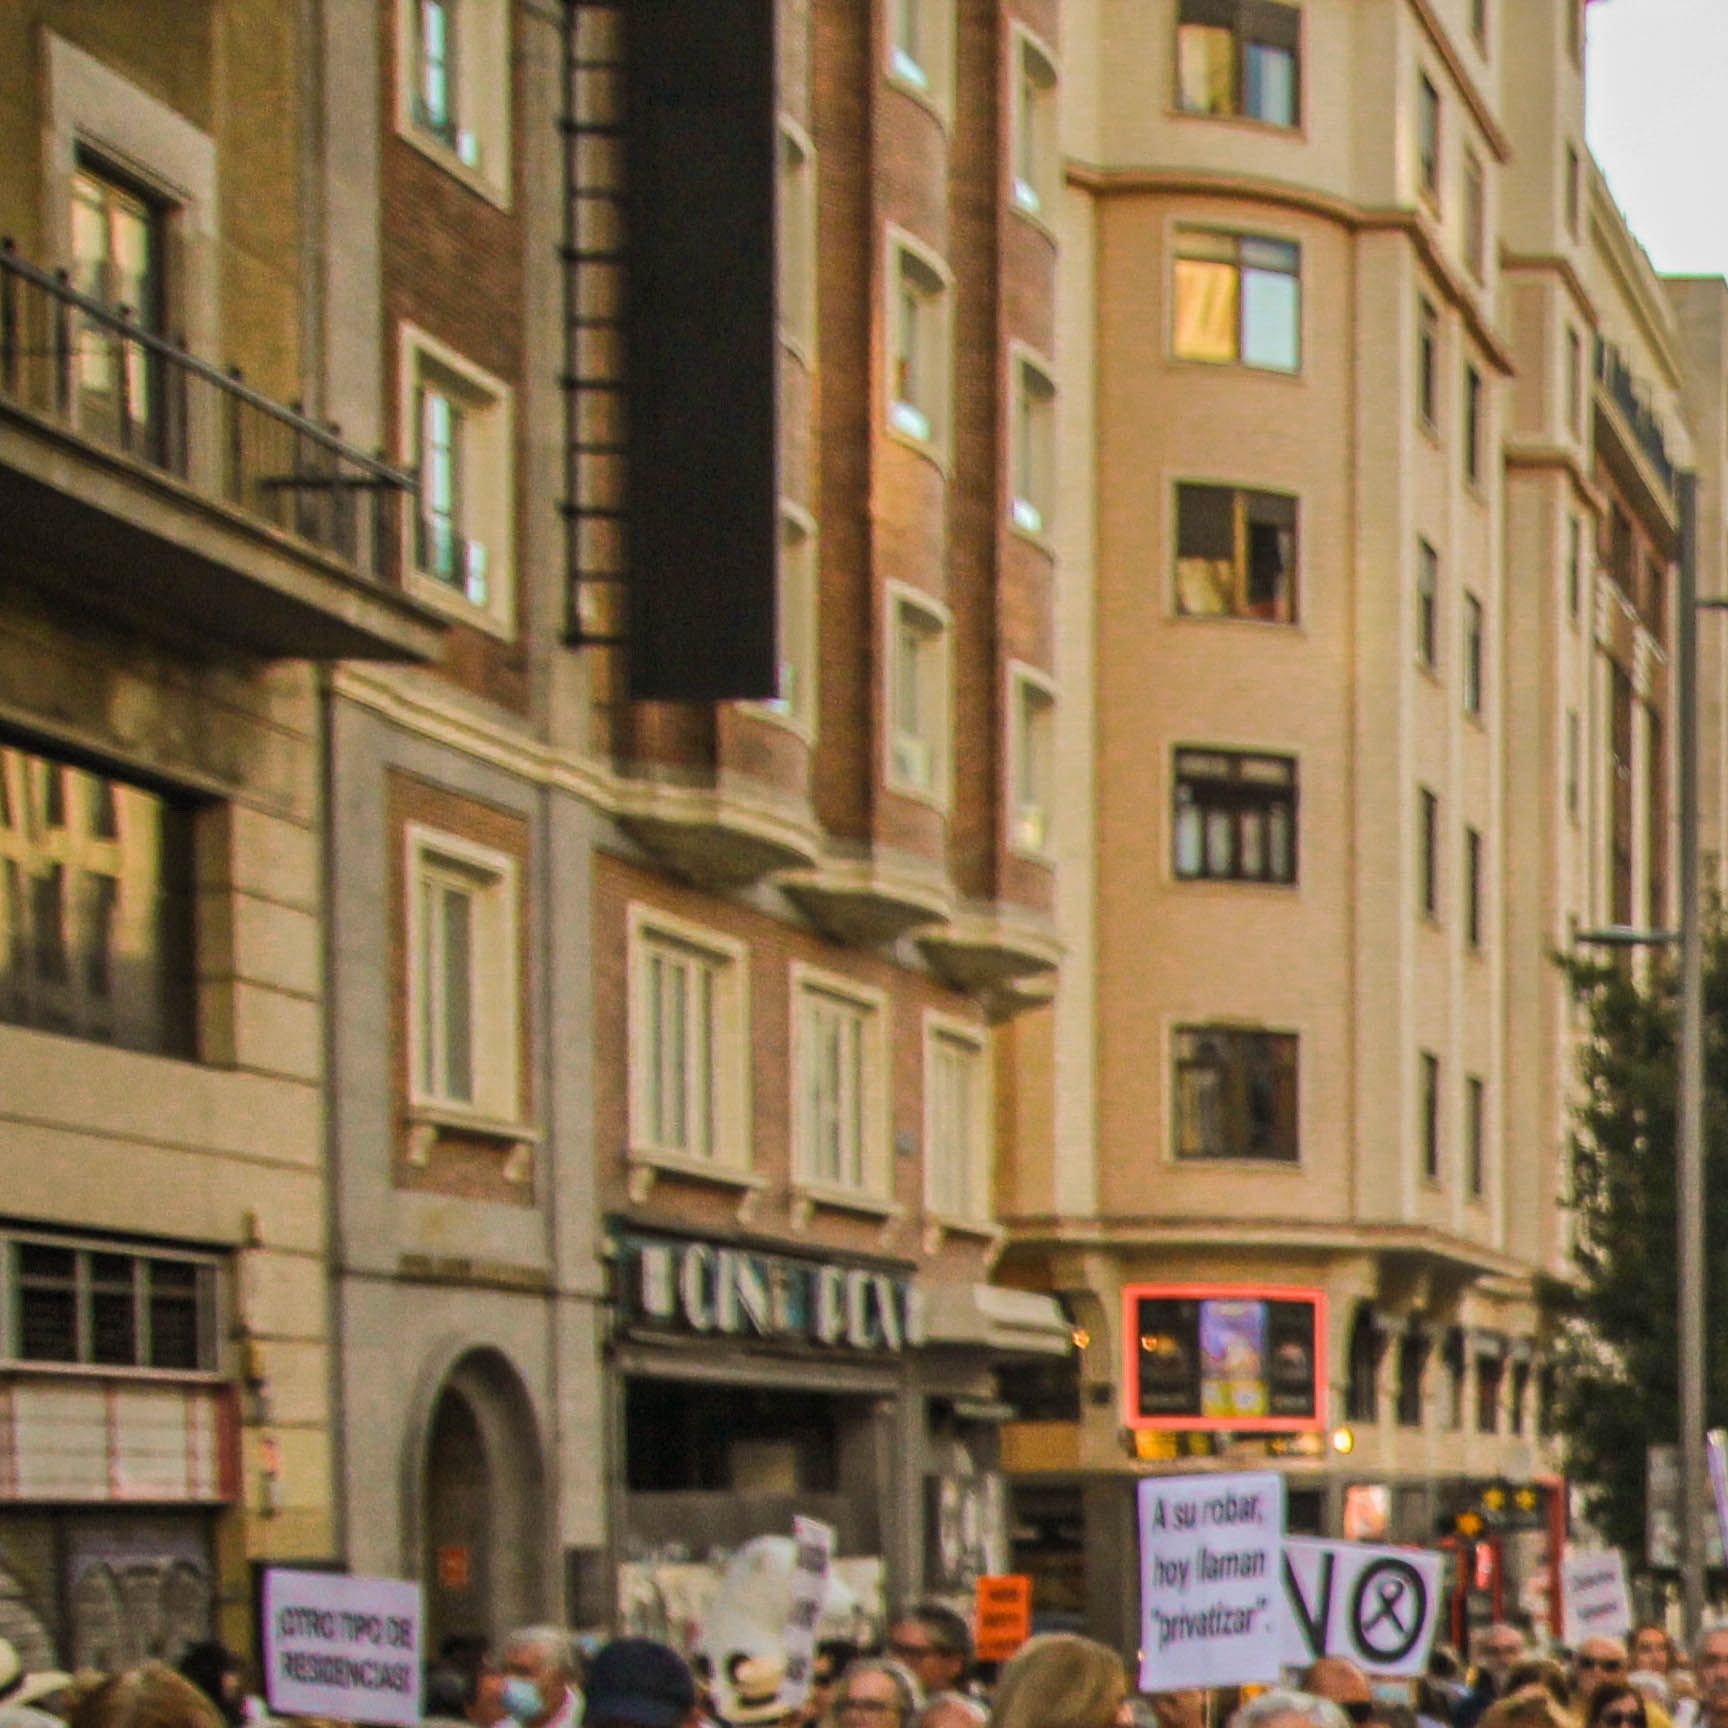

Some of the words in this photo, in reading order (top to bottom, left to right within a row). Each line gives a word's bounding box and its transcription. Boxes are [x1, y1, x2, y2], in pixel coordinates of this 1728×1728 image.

[1153, 1496, 1167, 1529] A
[1173, 1503, 1196, 1529] su
[1154, 1553, 1191, 1594] hoy
[1198, 1548, 1266, 1581] llaman
